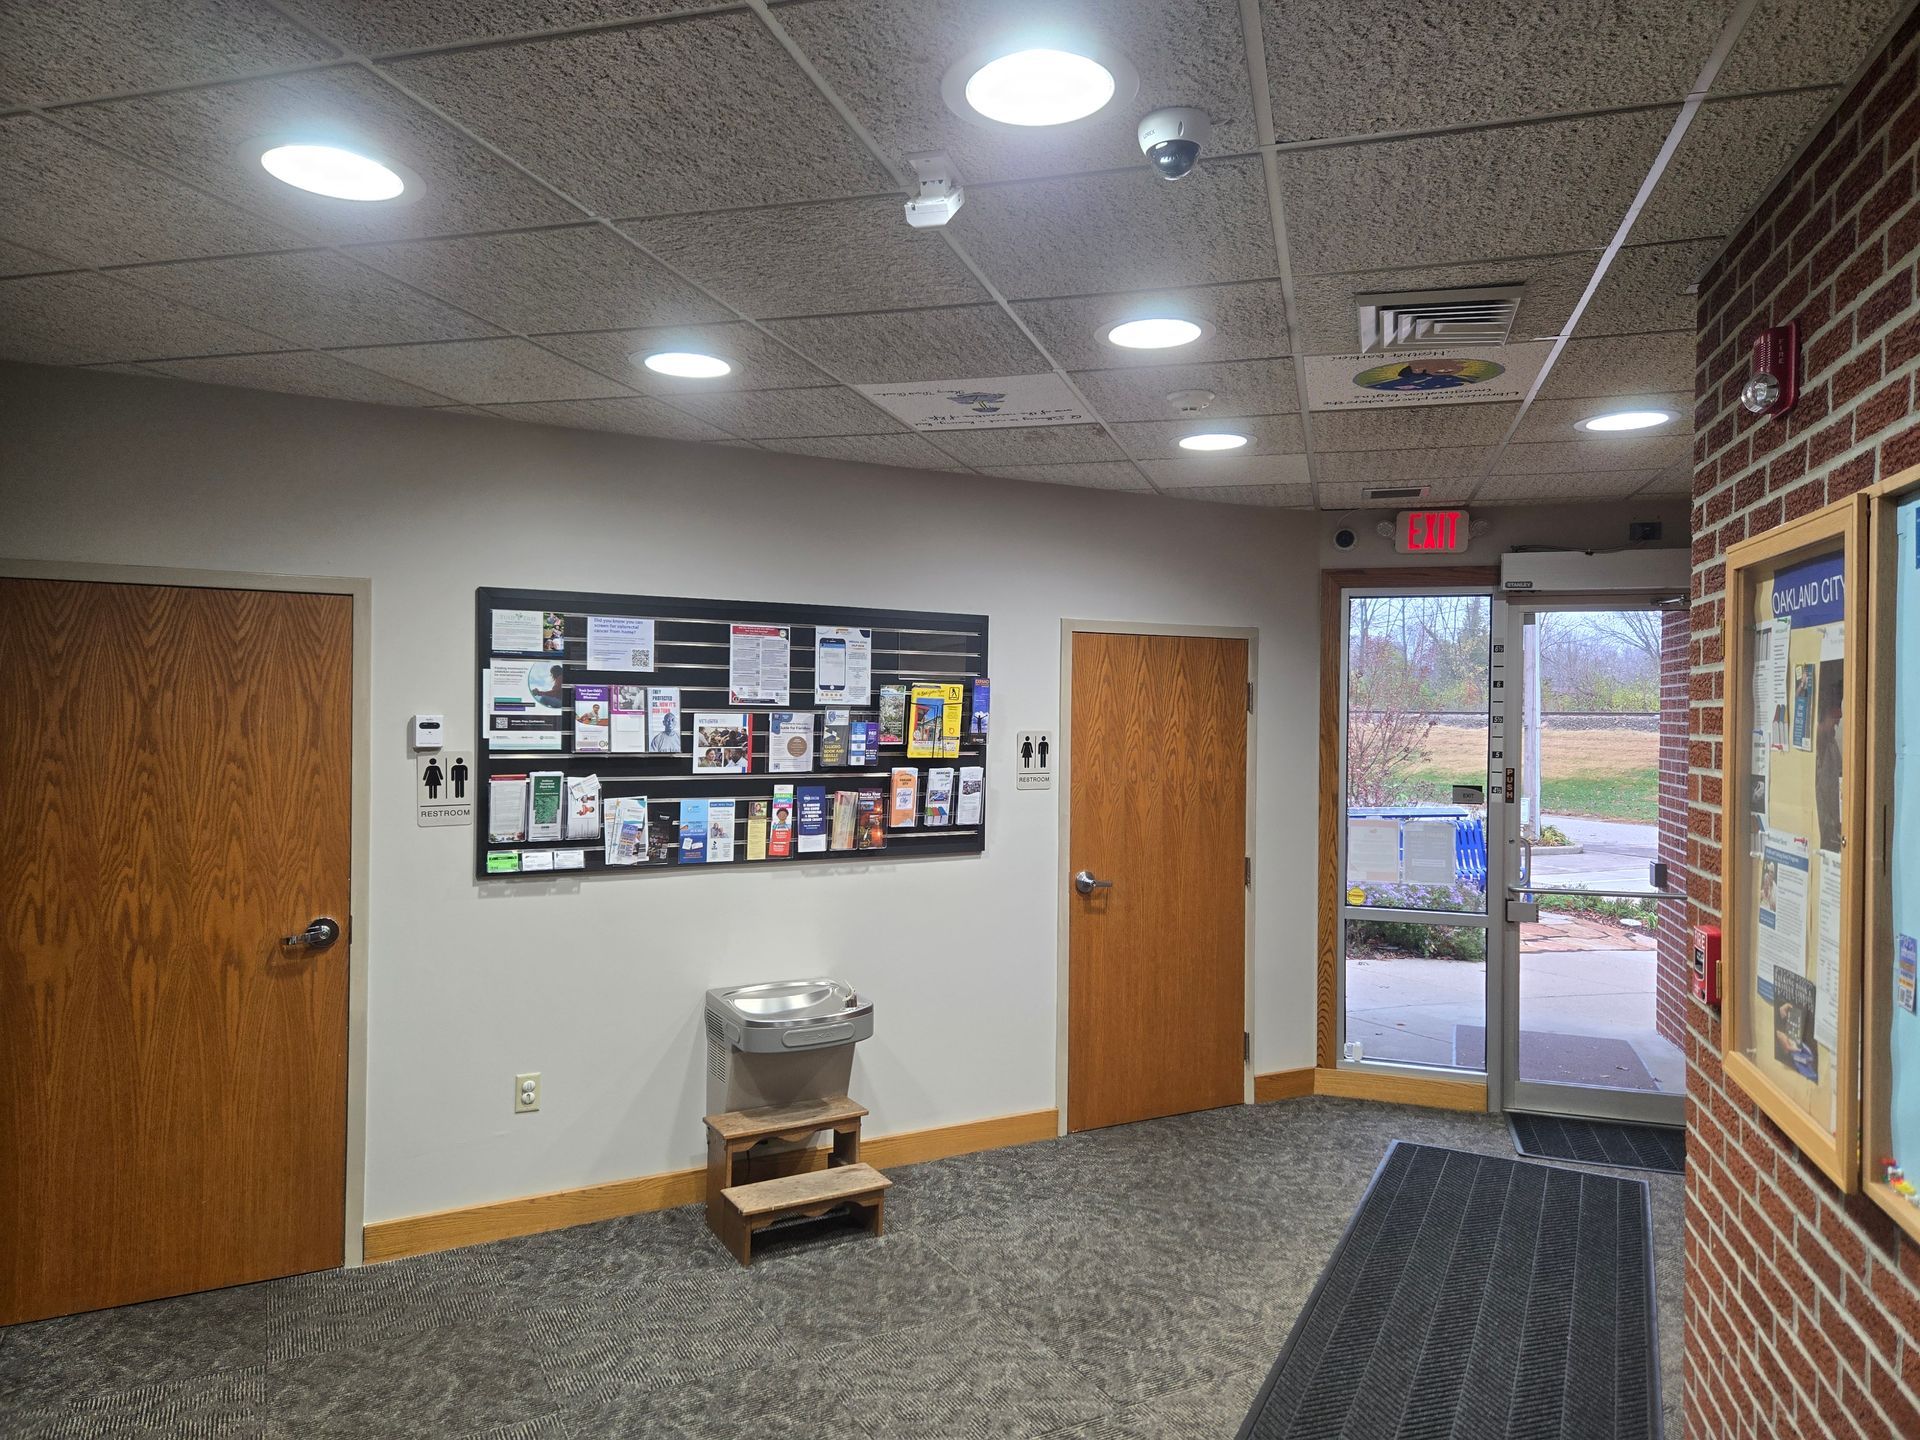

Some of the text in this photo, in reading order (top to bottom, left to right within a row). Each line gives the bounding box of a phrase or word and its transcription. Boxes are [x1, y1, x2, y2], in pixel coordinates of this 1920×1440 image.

[1408, 512, 1461, 550] EXIT
[1773, 581, 1819, 614] OAKLAND
[421, 809, 470, 818] RESTROOM
[1694, 930, 1705, 949] FIRE
